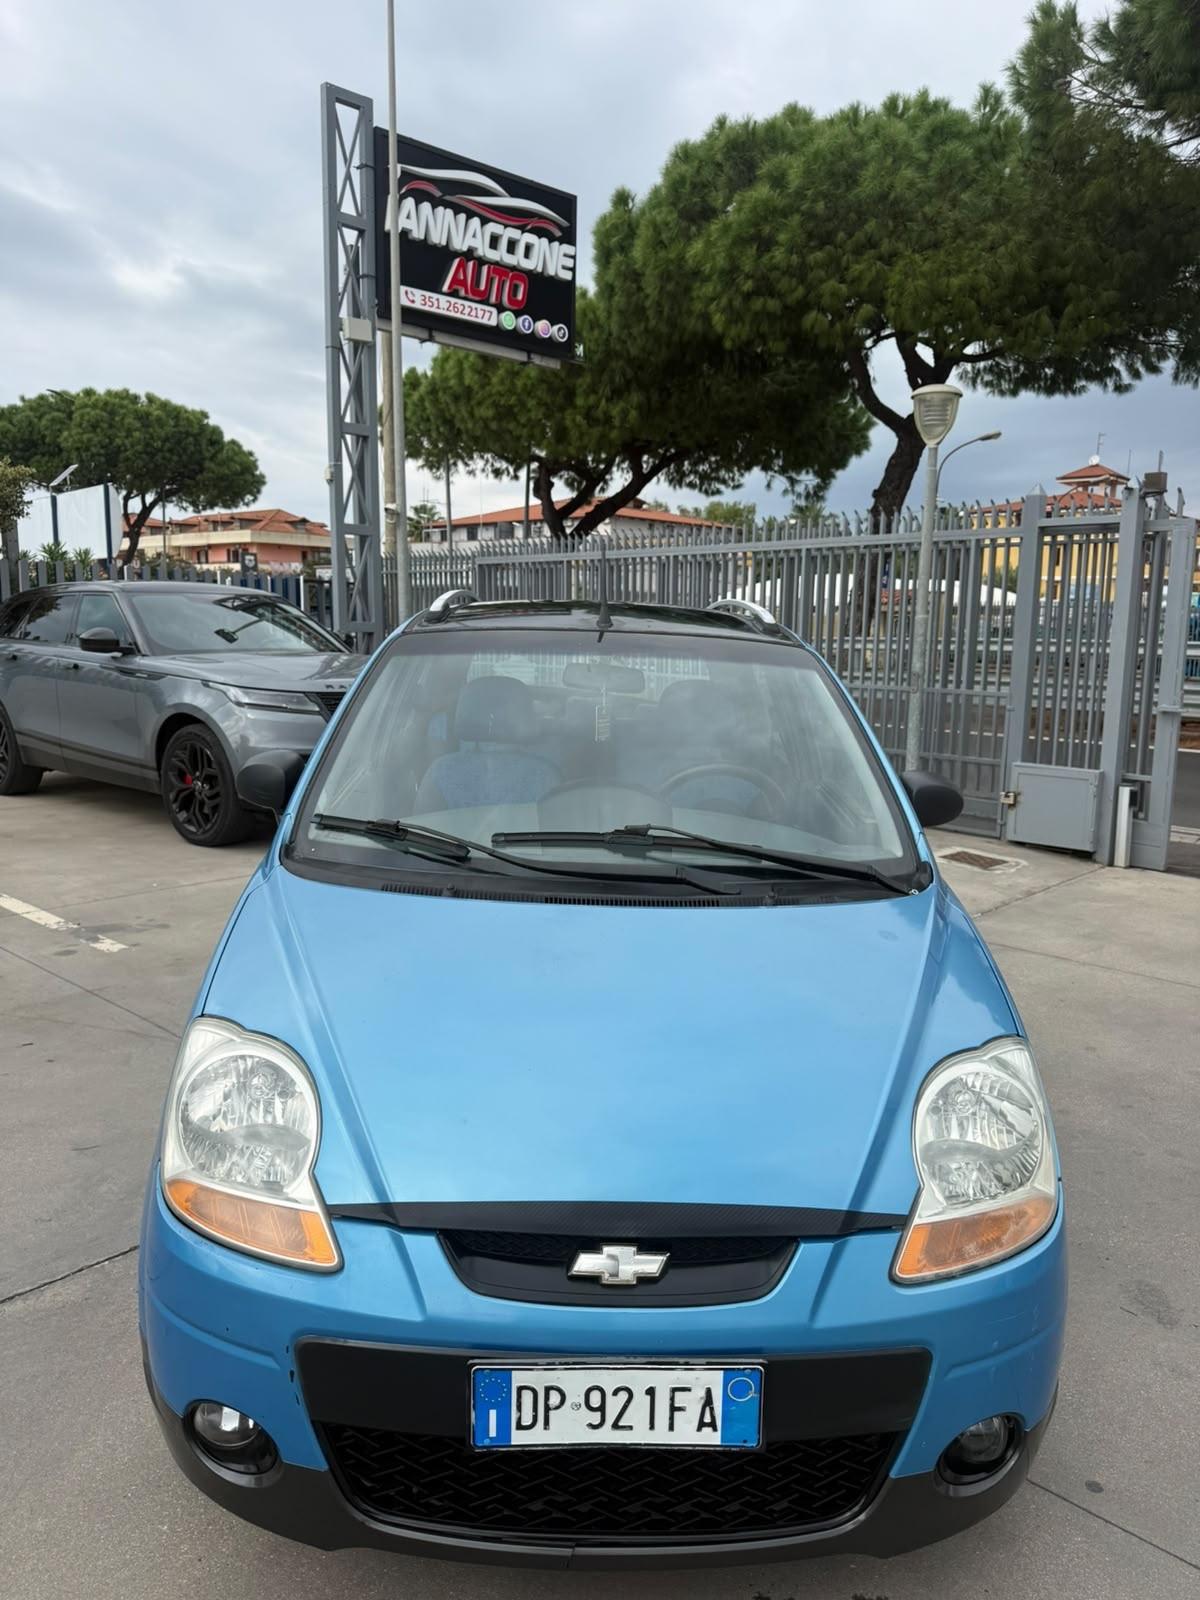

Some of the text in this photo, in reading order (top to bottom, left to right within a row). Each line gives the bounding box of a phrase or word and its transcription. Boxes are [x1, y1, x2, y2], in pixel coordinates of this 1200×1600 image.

[442, 256, 529, 310] AUTO
[420, 294, 493, 322] 351.2622177
[515, 1384, 719, 1433] DP 921FA
